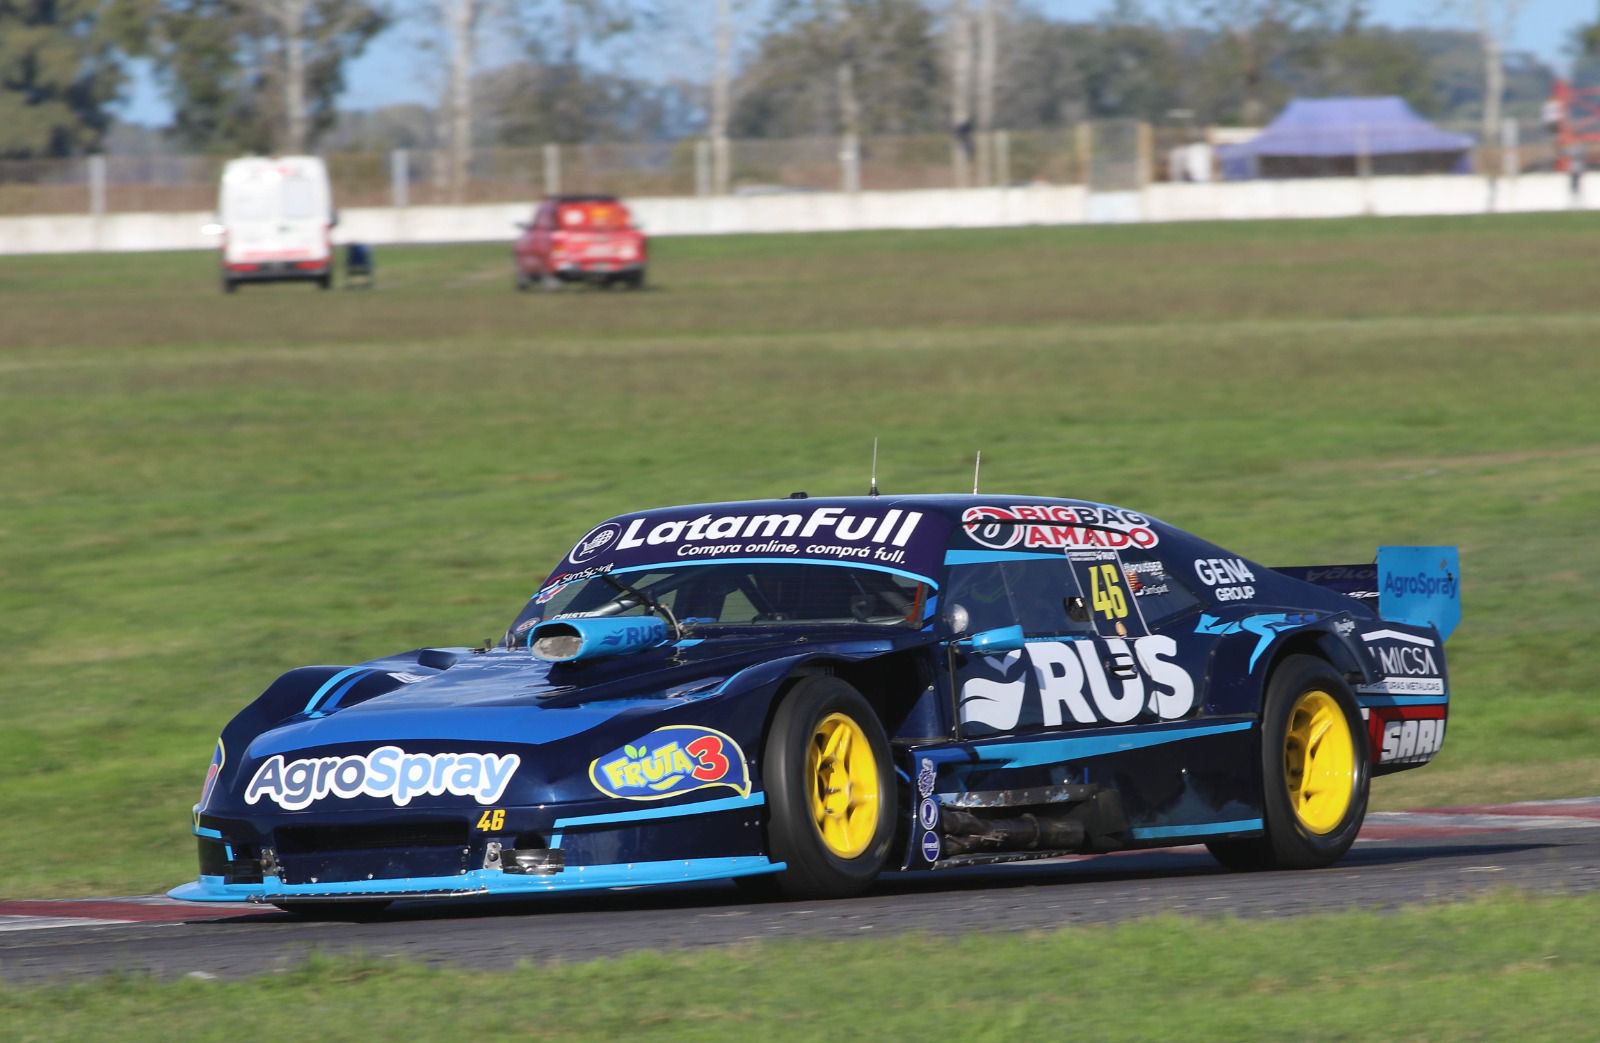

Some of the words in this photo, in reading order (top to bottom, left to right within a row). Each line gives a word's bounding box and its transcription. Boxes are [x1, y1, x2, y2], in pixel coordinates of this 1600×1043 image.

[616, 508, 923, 550] LatamFull
[1011, 506, 1150, 526] BIGBAG
[1026, 525, 1158, 549] AMADO
[677, 543, 744, 556] Compra
[745, 540, 799, 555] online,
[806, 543, 870, 558] comprá
[874, 547, 905, 564] full.
[1088, 564, 1128, 620] 46
[1215, 585, 1256, 601] GROUP
[1385, 571, 1458, 599] AgroSpray
[626, 624, 663, 646] RUS
[1025, 635, 1194, 726] RUS
[602, 741, 695, 789] FRUTA
[685, 735, 730, 782] 3
[244, 746, 521, 810] AgroSpray
[476, 810, 506, 831] 46
